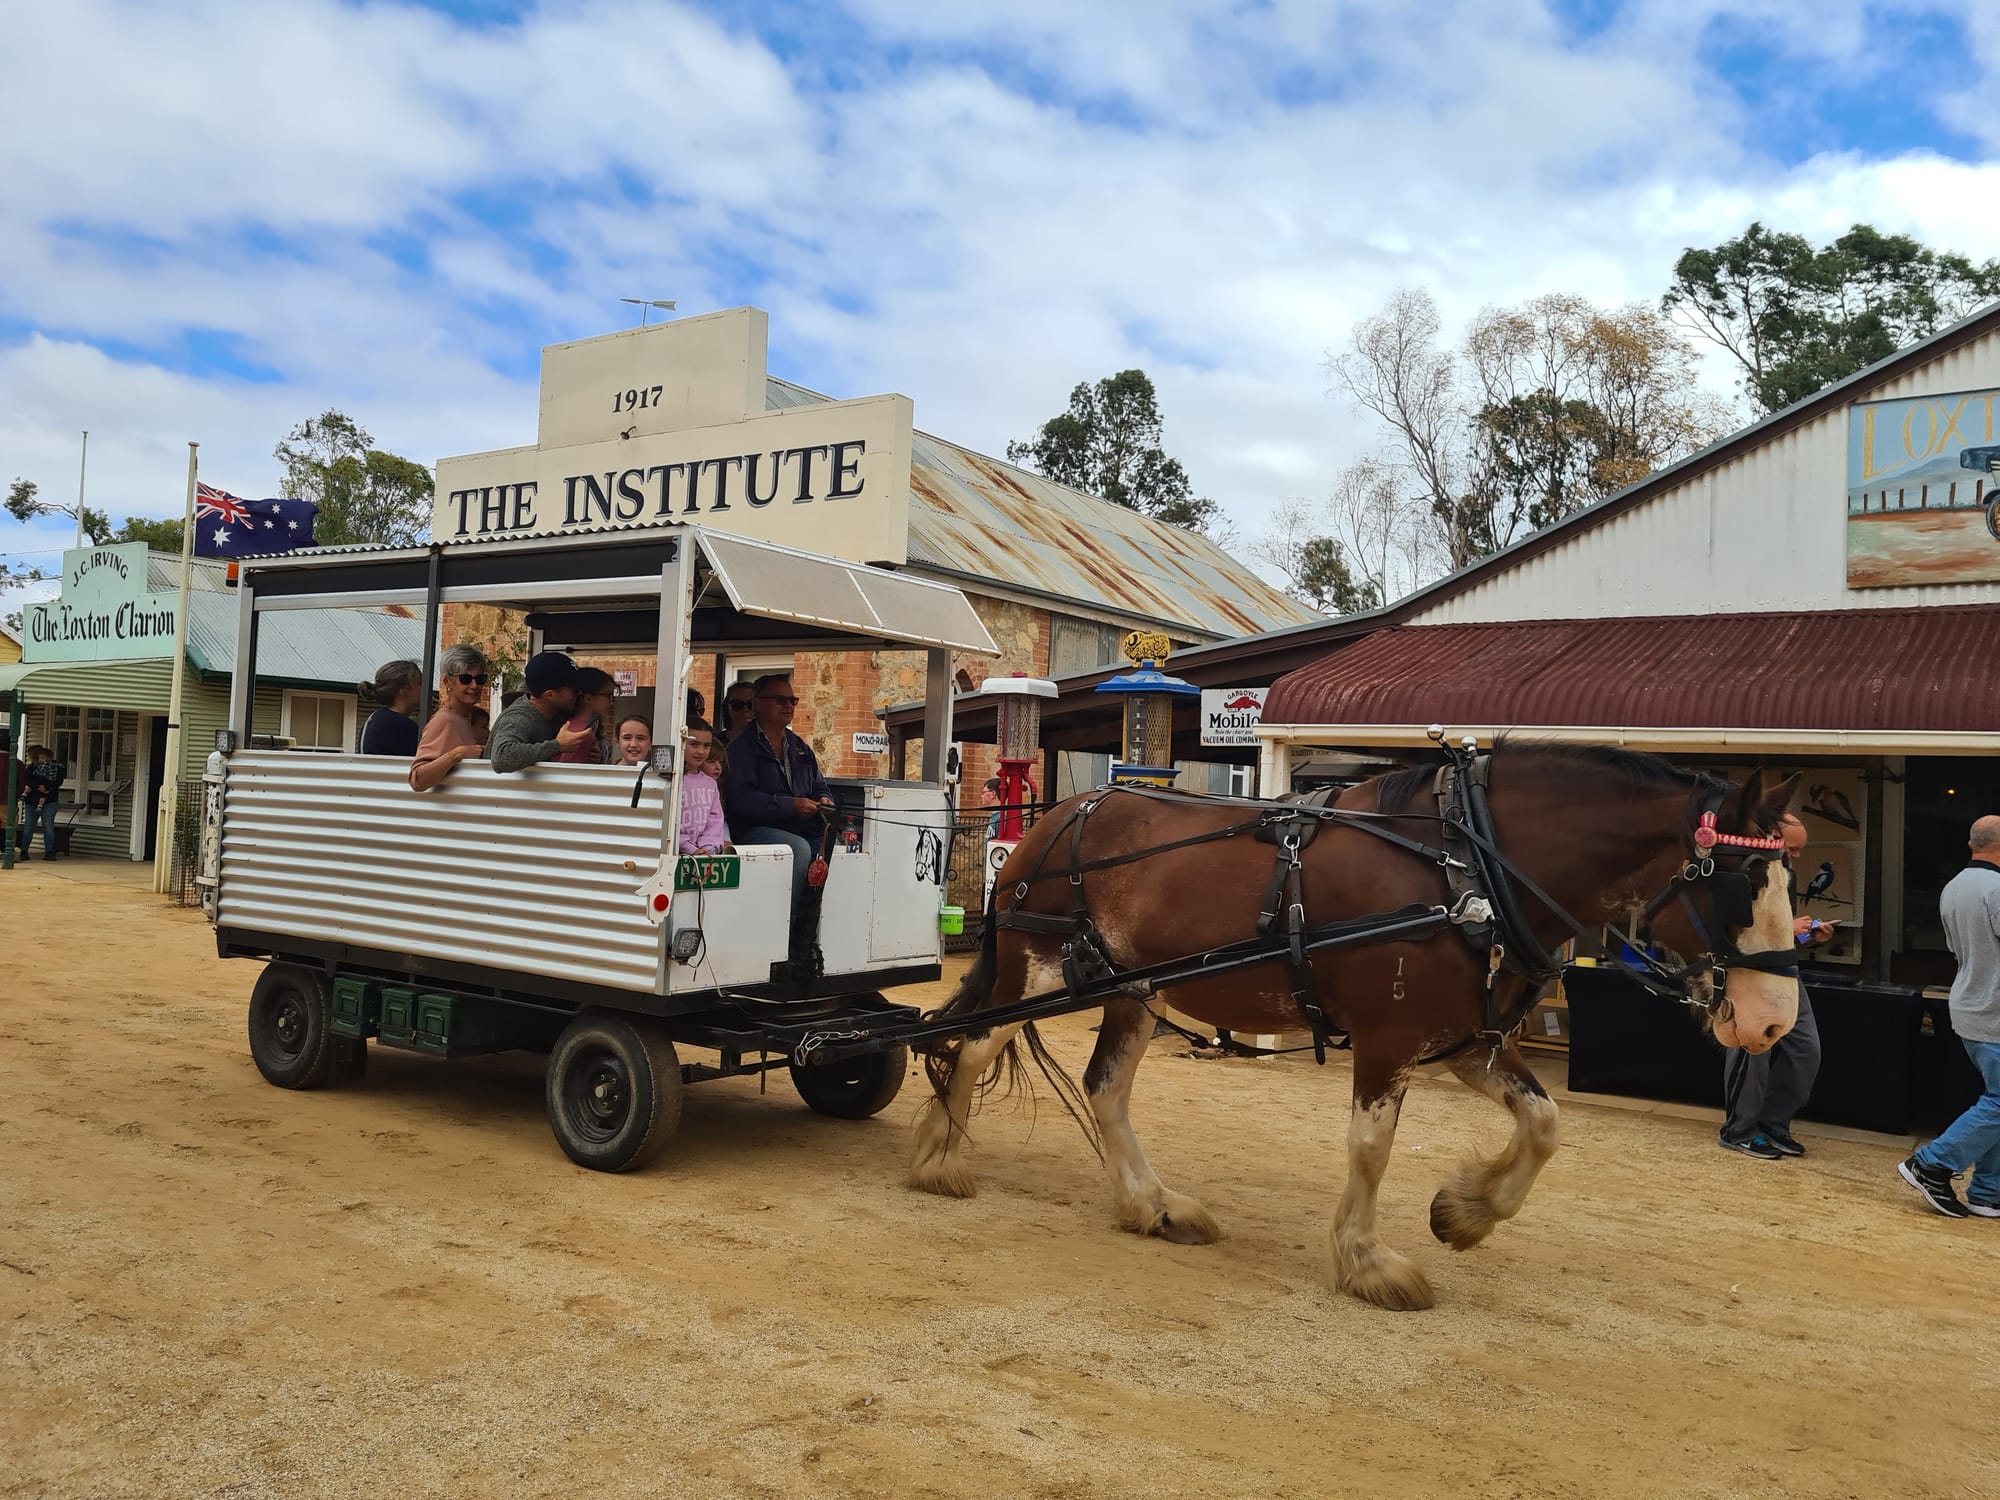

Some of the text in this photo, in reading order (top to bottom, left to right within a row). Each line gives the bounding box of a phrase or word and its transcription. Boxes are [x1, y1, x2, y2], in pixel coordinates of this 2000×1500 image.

[613, 385, 663, 413] 1917
[448, 440, 867, 537] THE INSTITUTE
[90, 551, 129, 581] IRVING
[32, 599, 175, 643] The Loxton Clarion
[1227, 689, 1259, 701] GARGOYLE
[1203, 735, 1225, 744] VACUUM
[1225, 735, 1235, 744] OIL
[680, 862, 731, 886] PATSY
